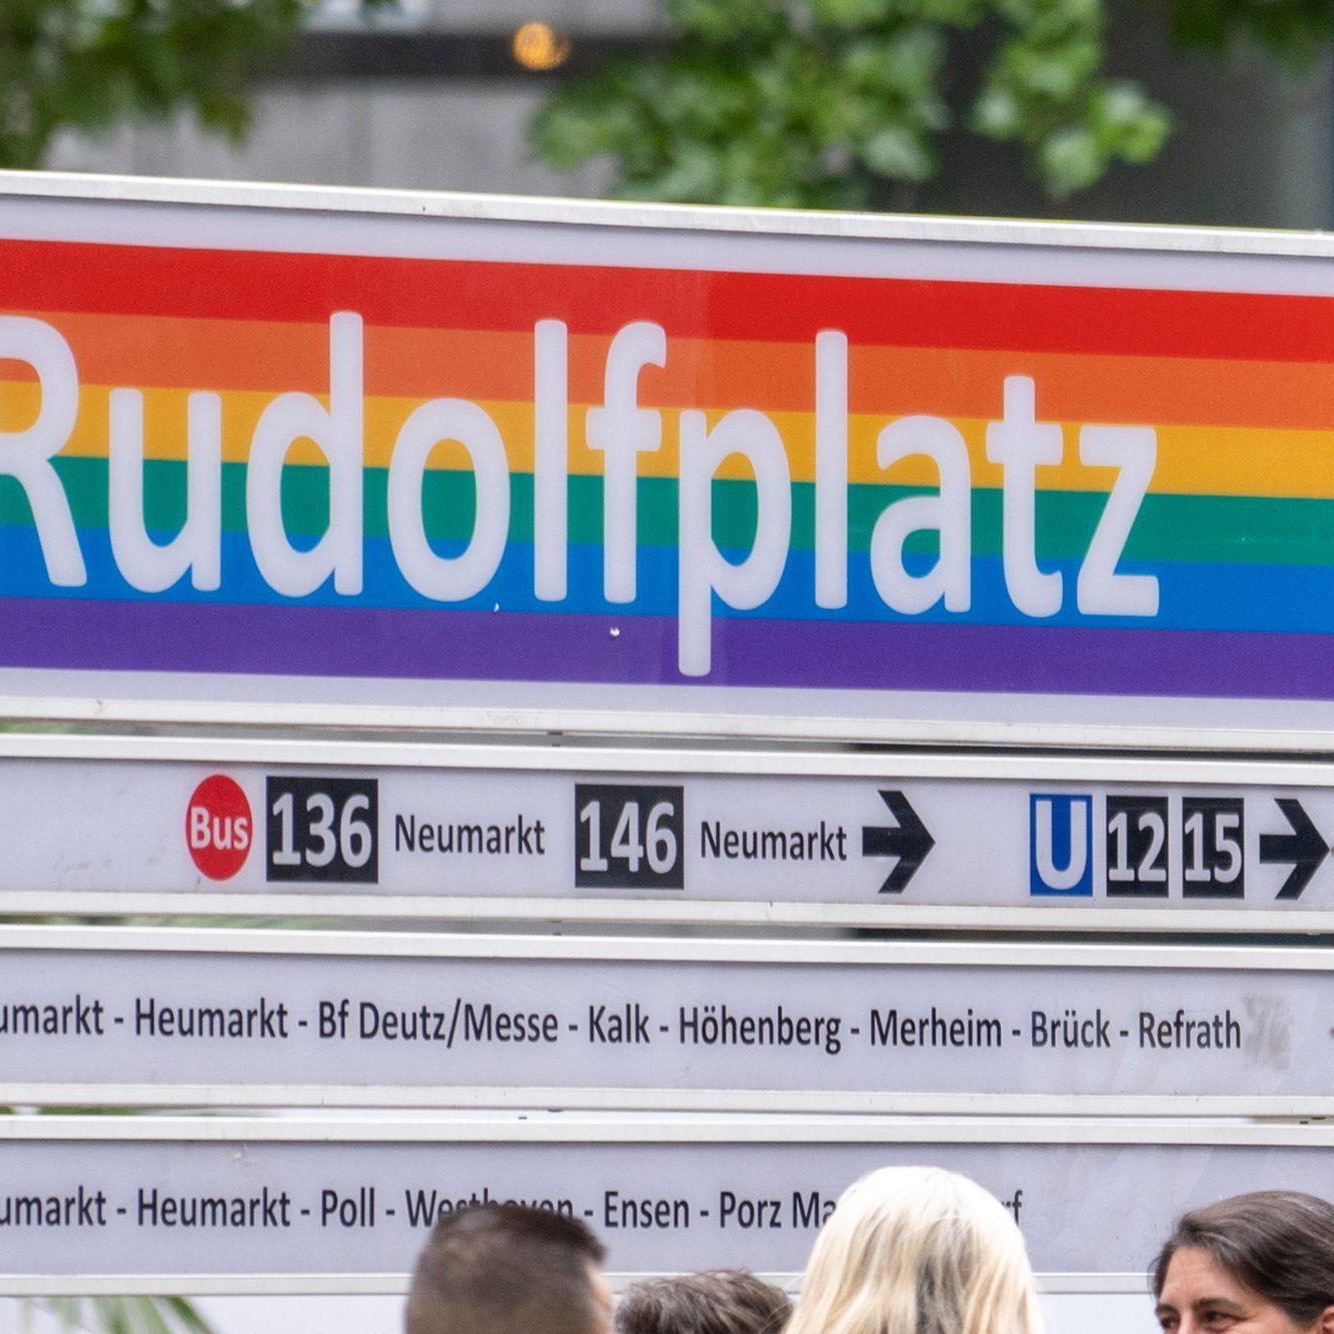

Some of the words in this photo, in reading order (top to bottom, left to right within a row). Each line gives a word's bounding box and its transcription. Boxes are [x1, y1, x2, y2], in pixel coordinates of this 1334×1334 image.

[190, 806, 250, 851] Bus
[272, 792, 372, 868] 136
[395, 814, 545, 855] Neumarkt
[580, 800, 677, 874] 146
[700, 820, 847, 861] Neumarkt
[1035, 799, 1088, 891] U
[1108, 811, 1167, 882] 12
[1184, 812, 1242, 883] 15
[135, 997, 289, 1039] Heumarkt
[319, 998, 350, 1039] Bf
[359, 997, 559, 1049] Deutz/Messe
[589, 1003, 651, 1044] Kalk
[679, 1004, 842, 1056] Höhenberg
[870, 1006, 1002, 1048] Merheim
[1031, 1008, 1111, 1048] Brück
[1139, 1009, 1241, 1049] Refrath
[137, 1186, 291, 1228] Heumarkt
[321, 1186, 375, 1228] Poll
[604, 1190, 690, 1229] Ensen
[719, 1191, 782, 1229] Porz
